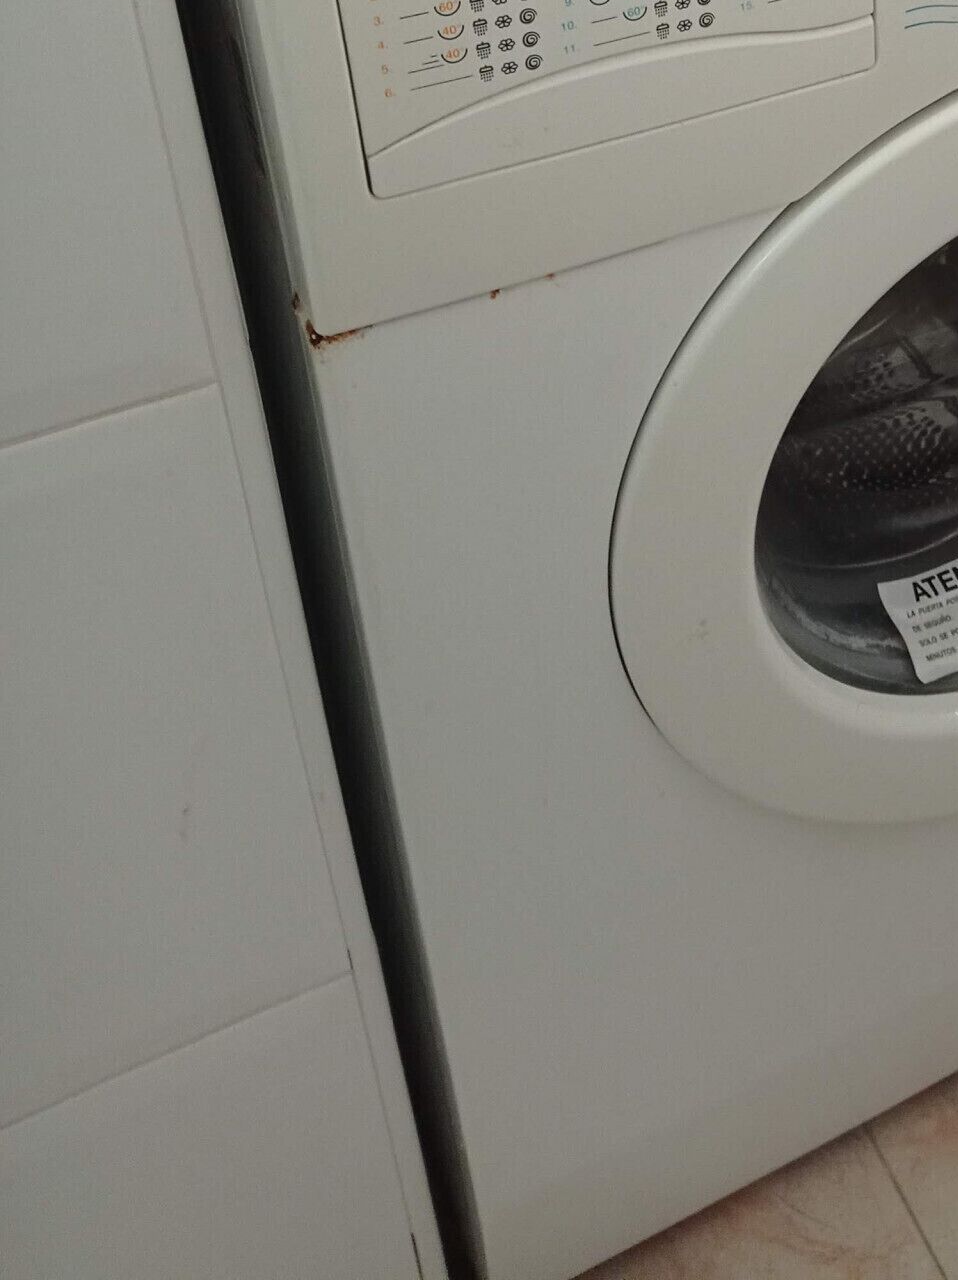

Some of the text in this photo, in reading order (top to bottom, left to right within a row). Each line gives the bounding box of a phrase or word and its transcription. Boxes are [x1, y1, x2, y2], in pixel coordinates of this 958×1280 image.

[906, 609, 916, 619] LA
[918, 602, 943, 615] PUERTA
[912, 624, 922, 633] DE
[918, 635, 938, 647] SOLO
[939, 631, 948, 641] SE
[925, 646, 957, 662] MINUTOS
